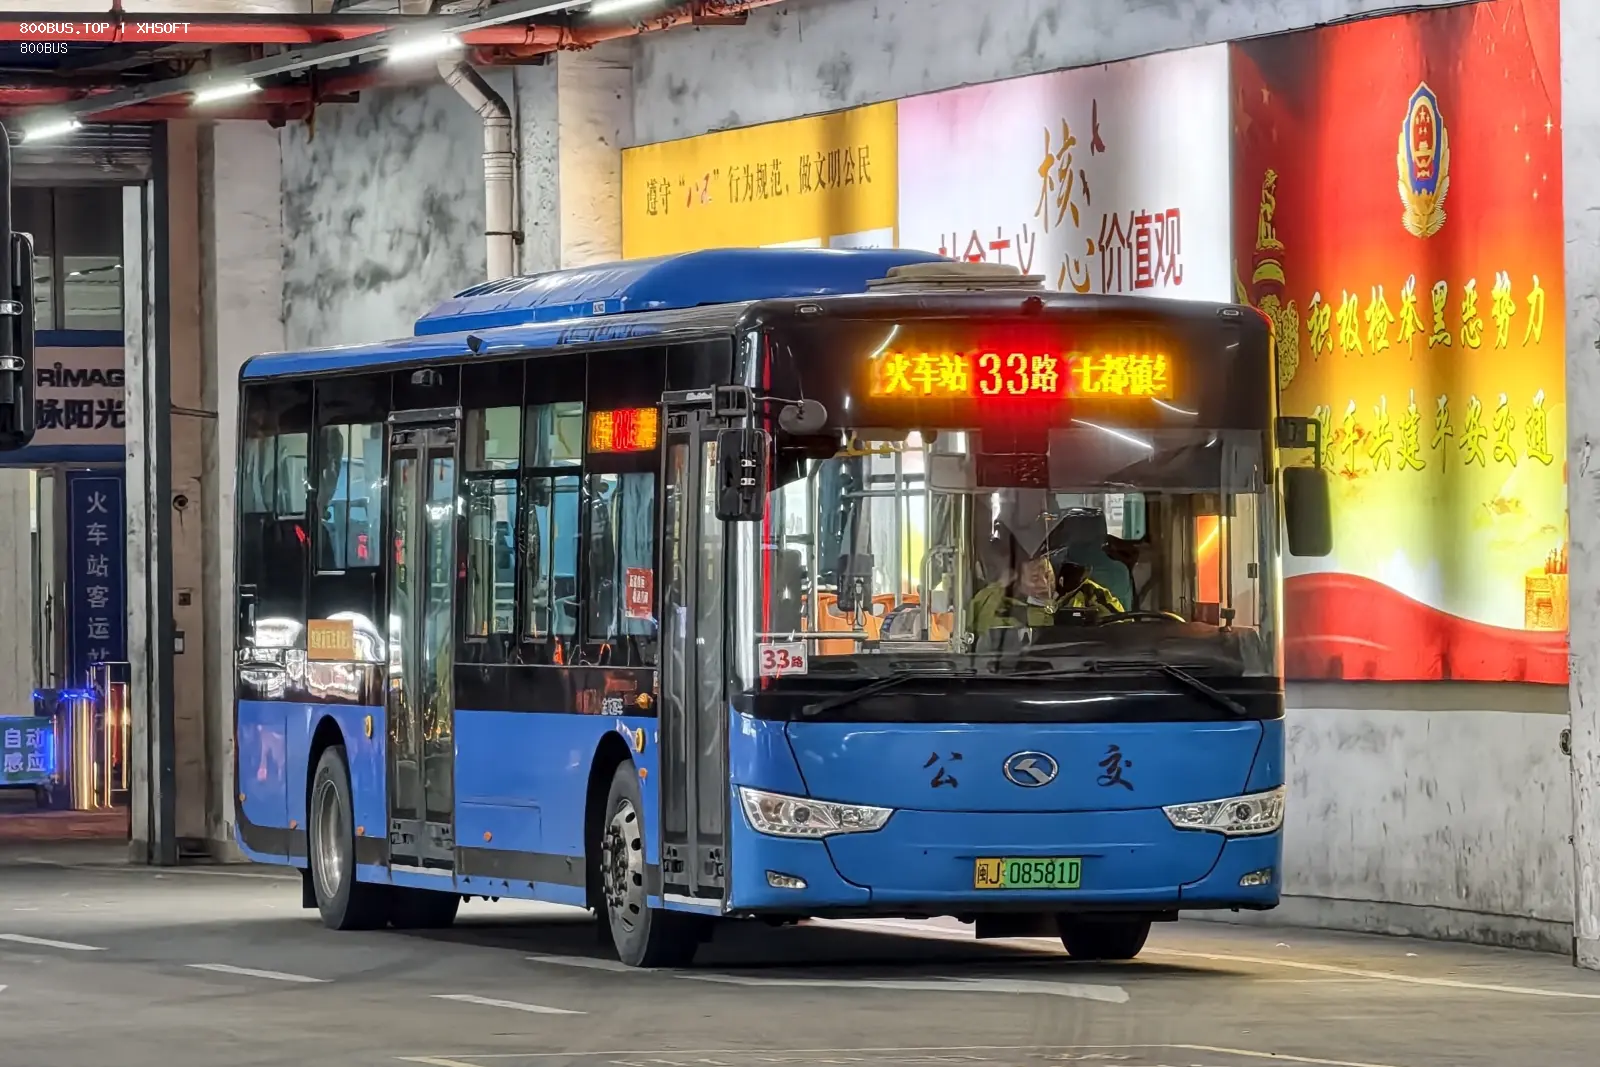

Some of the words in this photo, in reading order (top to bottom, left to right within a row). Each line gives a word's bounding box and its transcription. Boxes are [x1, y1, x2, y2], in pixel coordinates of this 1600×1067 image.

[1098, 207, 1184, 294] 价值观
[1306, 270, 1546, 359] 积极检举黑恶势力
[885, 353, 968, 394] 火车站
[4, 727, 46, 749] 自动
[3, 752, 47, 773] 感应
